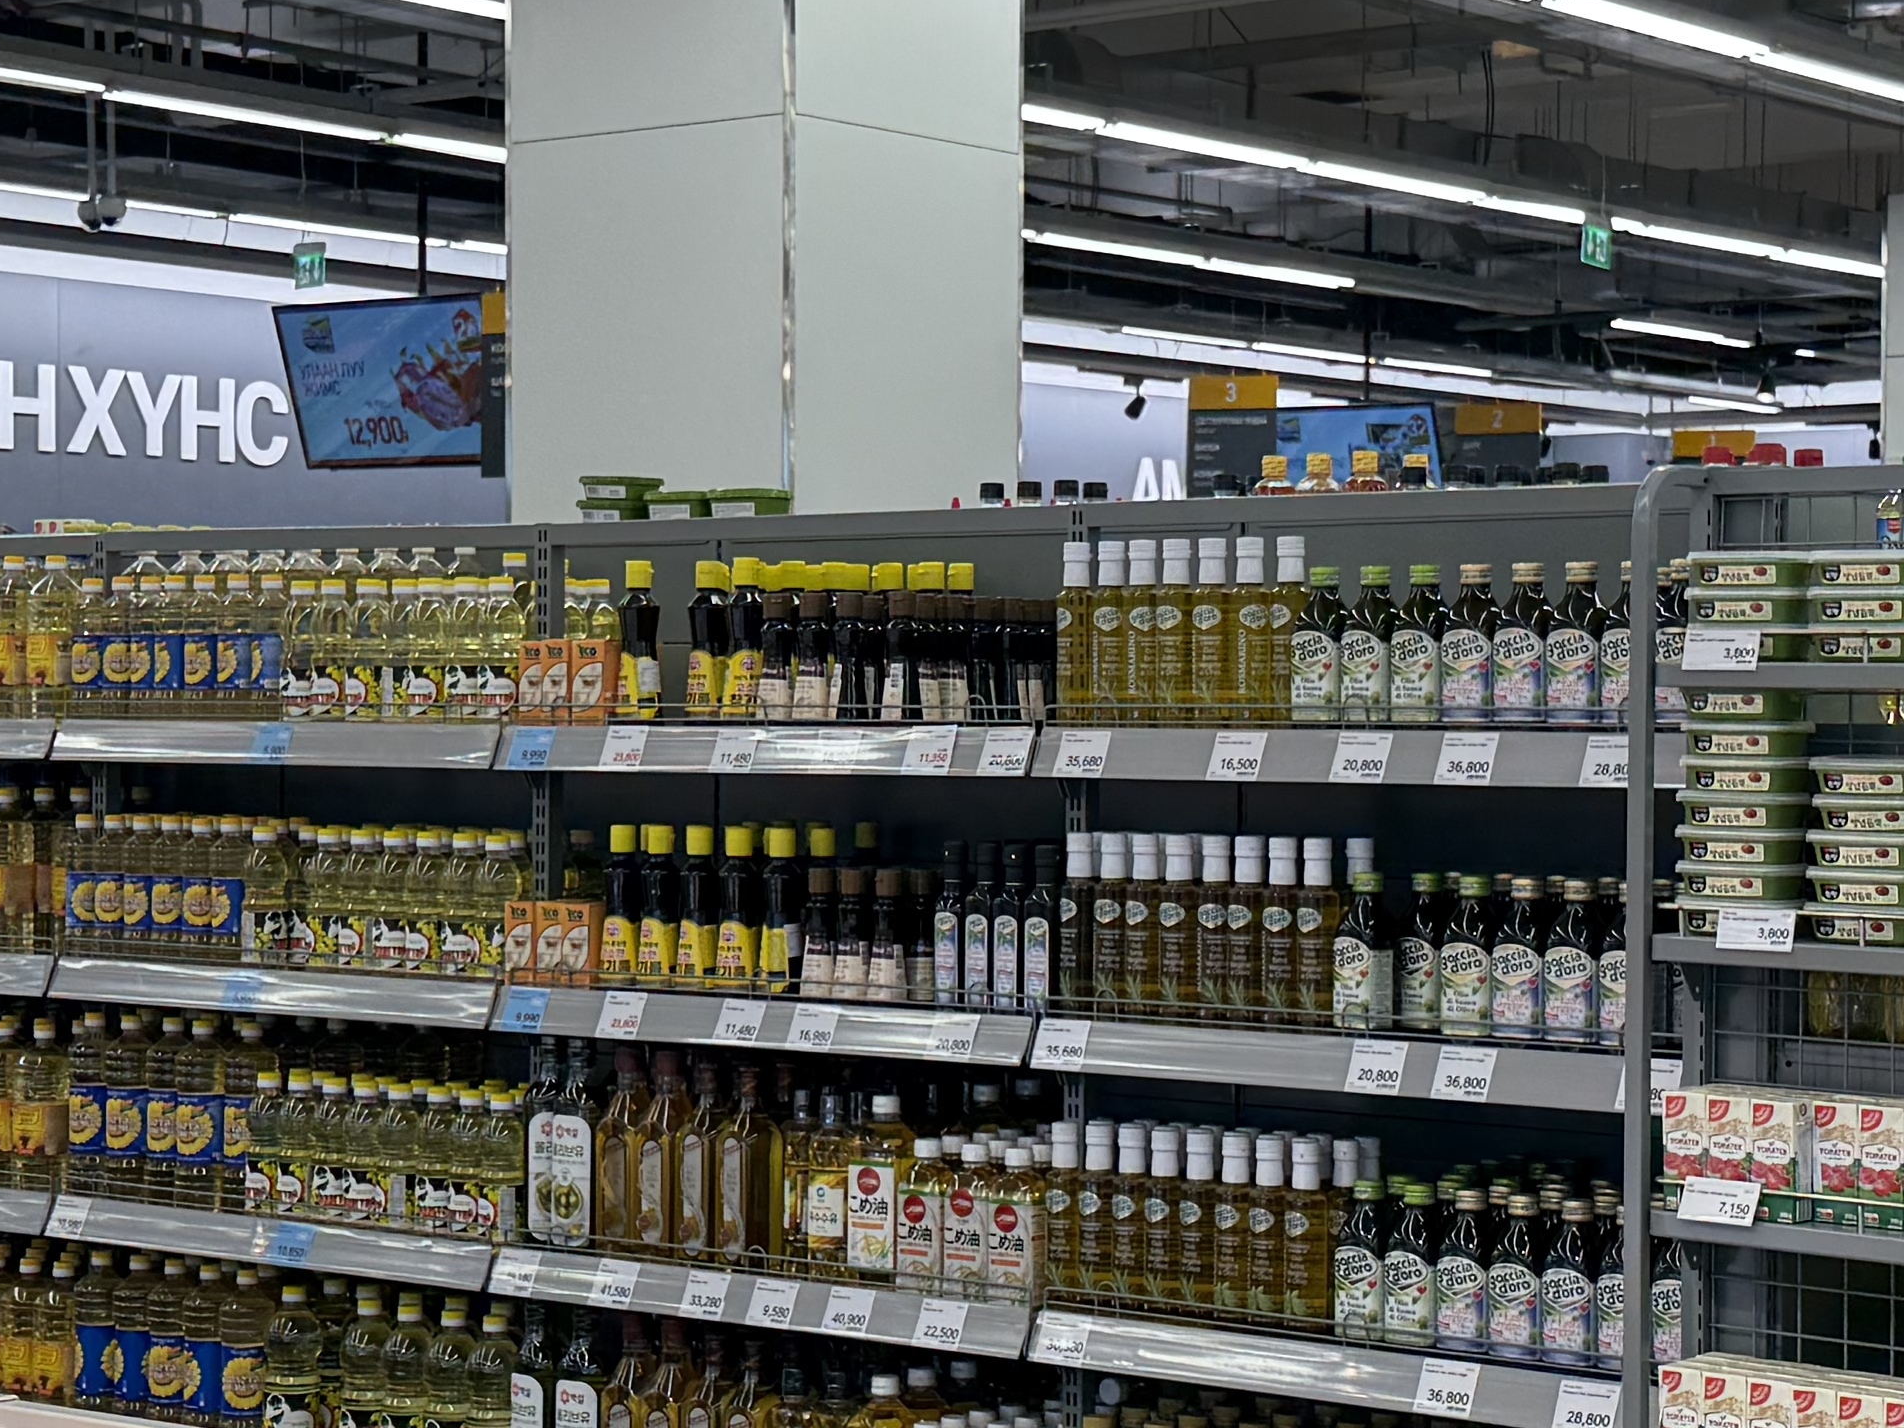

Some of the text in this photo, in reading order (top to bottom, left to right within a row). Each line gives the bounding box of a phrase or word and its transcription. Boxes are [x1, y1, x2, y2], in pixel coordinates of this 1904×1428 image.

[1225, 382, 1237, 403] 3
[66, 365, 288, 467] ХҮНС
[1219, 756, 1259, 772] 16,500
[1341, 758, 1384, 774] 20,800
[1445, 759, 1490, 775] 36,800
[1592, 762, 1629, 778] 28,80
[1044, 1044, 1084, 1060] 35,680
[1356, 1067, 1400, 1084] 20,800
[1444, 1074, 1488, 1091] 36,800
[1718, 1200, 1751, 1217] 7,150
[924, 1326, 961, 1340] 22,500
[1426, 1386, 1471, 1406] 36,800
